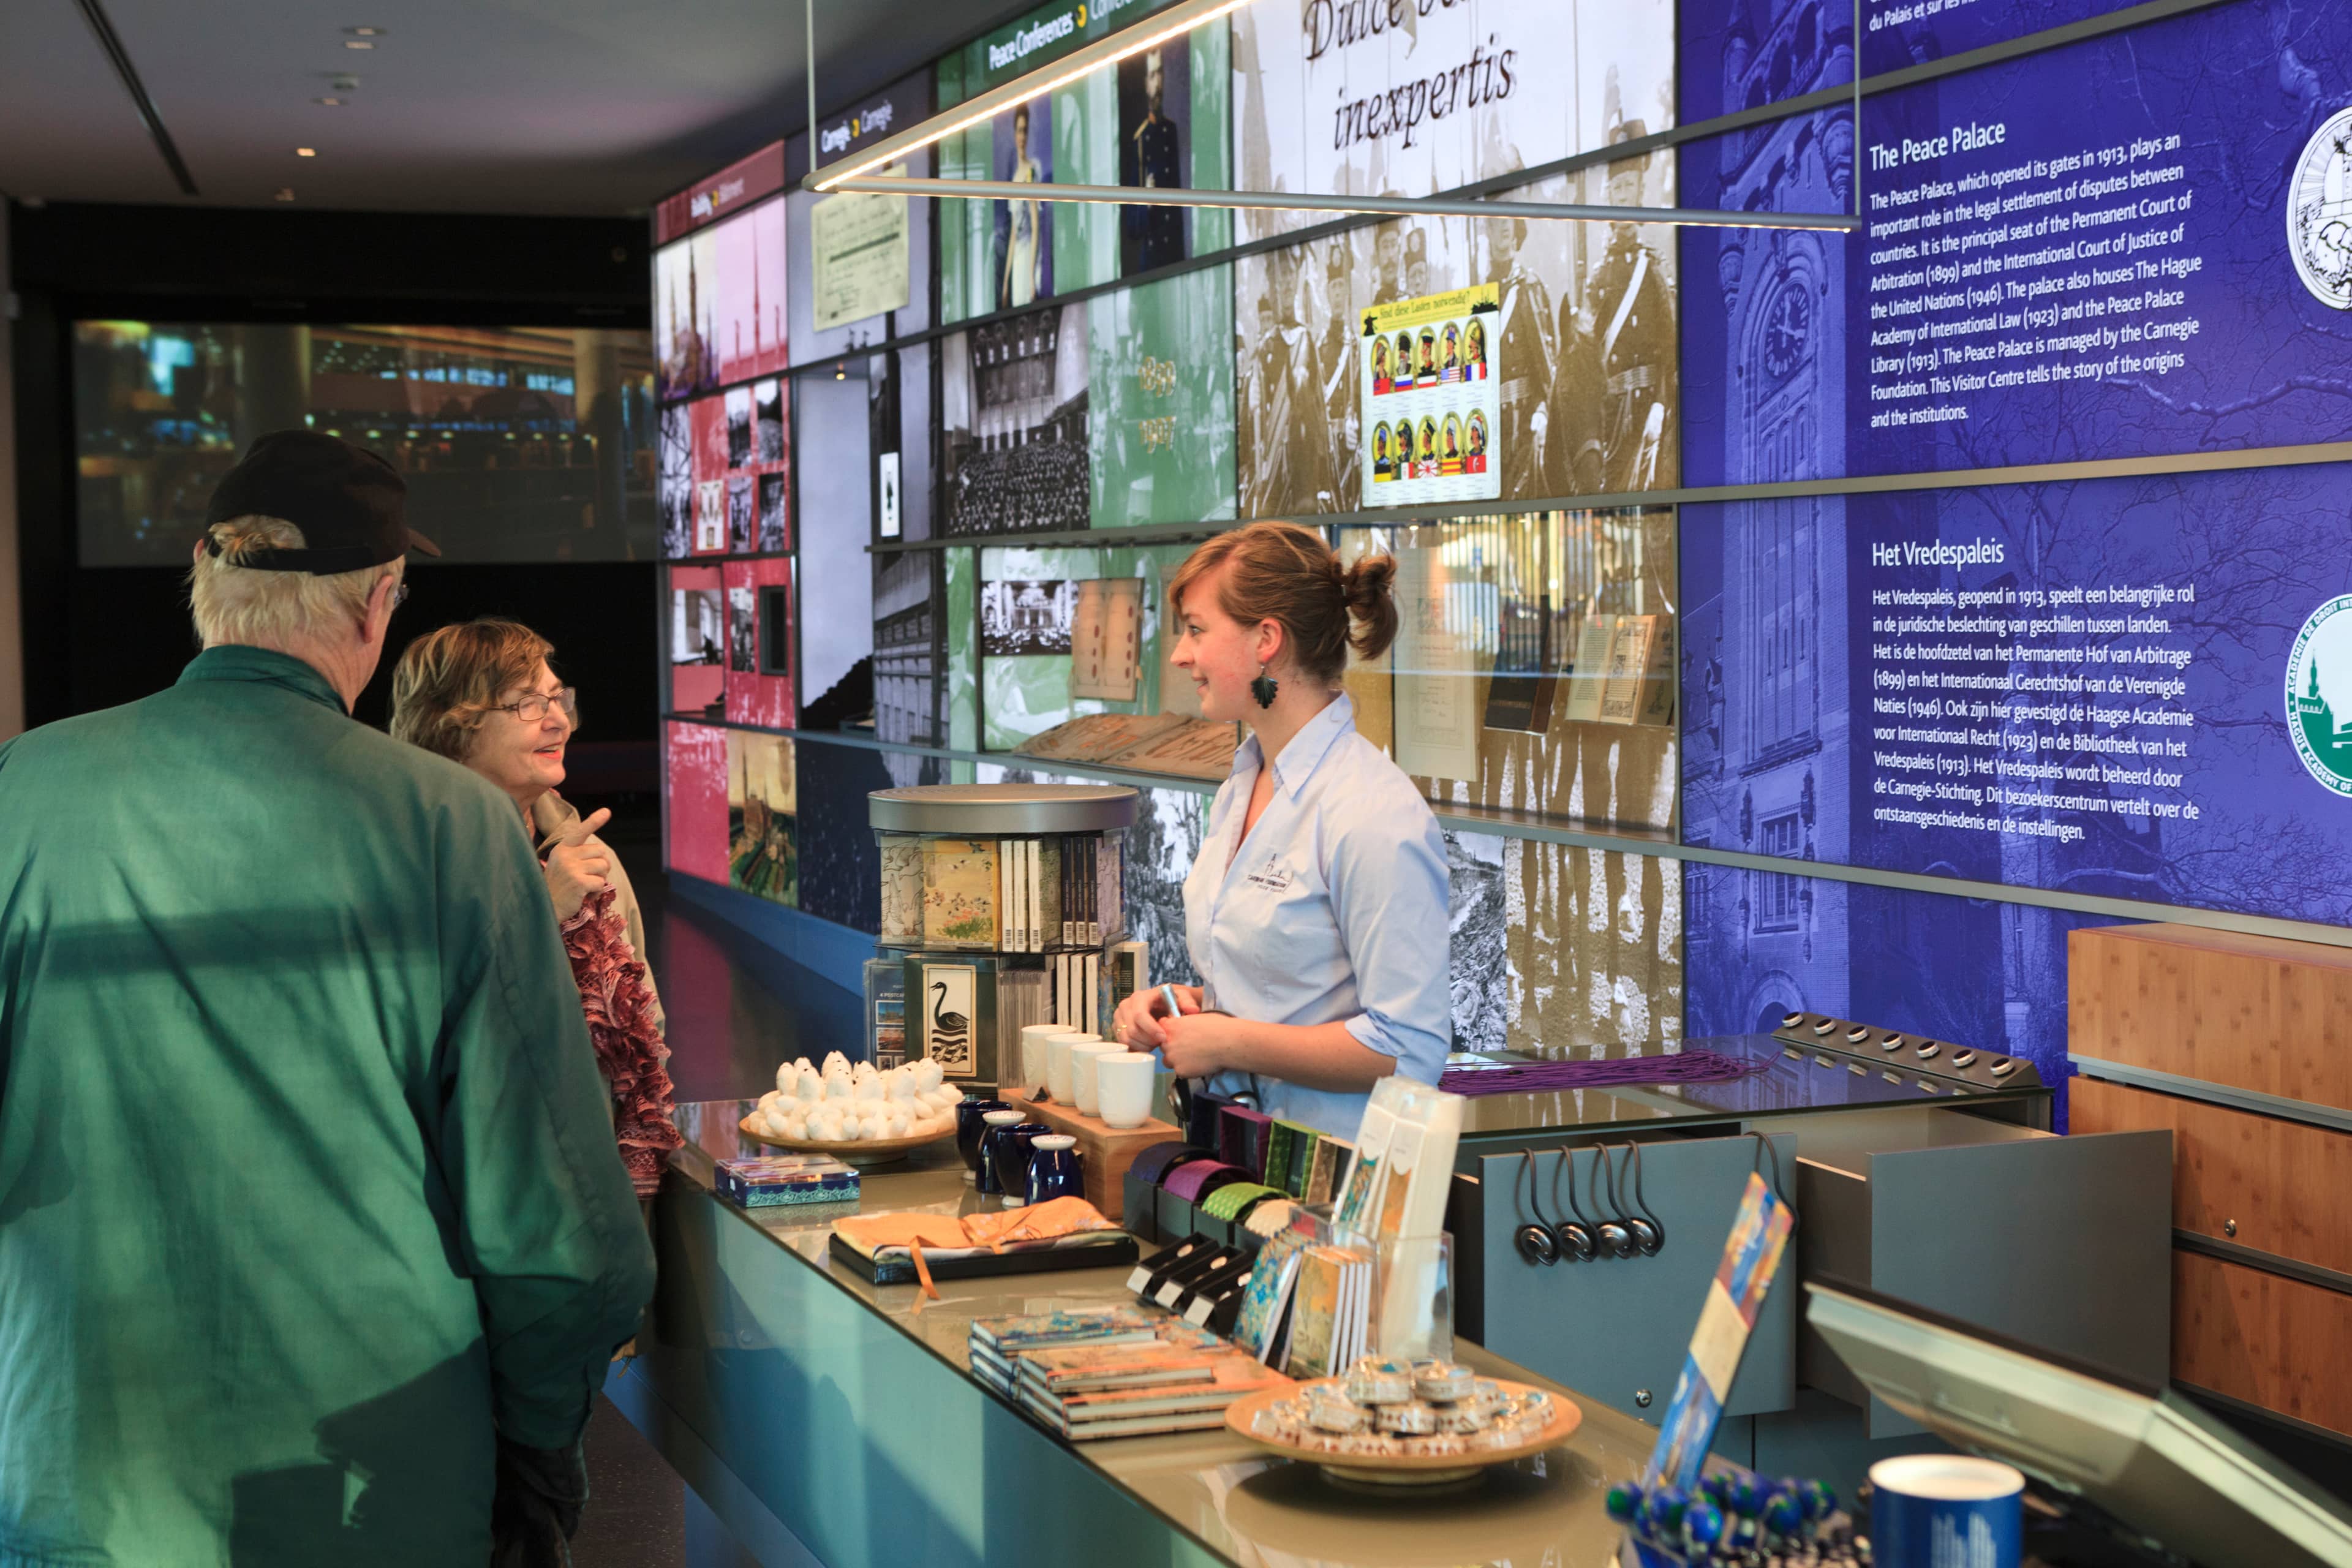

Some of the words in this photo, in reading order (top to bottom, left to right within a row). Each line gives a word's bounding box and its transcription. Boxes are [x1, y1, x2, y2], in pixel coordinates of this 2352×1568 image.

[989, 40, 1017, 71] Peace
[1016, 11, 1074, 58] Conferences
[1869, 13, 1882, 31] du
[1885, 5, 1912, 28] Palais
[1913, 2, 1925, 19] et
[1927, 0, 1943, 15] sur
[1335, 33, 1515, 151] inexpertis
[1869, 143, 1899, 171] The
[1902, 136, 1948, 164] Peace
[1952, 123, 2005, 153] Palace
[1870, 192, 1889, 210] The
[1890, 189, 1920, 206] Peace
[1921, 181, 1956, 200] Palace,
[1957, 170, 1989, 192] which
[1991, 160, 2032, 189] opened
[2034, 160, 2048, 177] its
[2049, 155, 2081, 179] gates
[2082, 149, 2095, 167] in
[2097, 146, 2128, 167] 1913,
[2130, 138, 2163, 163] plays
[2164, 134, 2180, 151] an
[1870, 215, 1920, 241] important
[1921, 209, 1942, 228] role
[1943, 208, 1953, 224] in
[1954, 204, 1973, 222] the
[1975, 197, 2000, 221] legal
[2002, 187, 2063, 213] settlement
[2064, 181, 2078, 201] of
[2079, 176, 2128, 200] disputes
[2130, 165, 2184, 189] between
[1870, 243, 1919, 265] countries.
[1921, 240, 1929, 256] It
[1931, 238, 1940, 254] is
[1942, 235, 1960, 252] the
[1961, 224, 2008, 254] principal
[2010, 222, 2034, 241] seat
[2035, 216, 2048, 236] of
[2049, 214, 2070, 233] the
[2072, 203, 2138, 229] Permanent
[2139, 195, 2176, 217] Court
[2177, 191, 2192, 211] of
[1870, 270, 1924, 292] Arbitration
[1926, 261, 1960, 287] (1899)
[1961, 258, 1982, 277] and
[1983, 256, 2002, 274] the
[2003, 241, 2075, 270] International
[2077, 238, 2111, 258] Court
[2112, 233, 2126, 253] of
[2127, 228, 2168, 255] Justice
[2170, 224, 2184, 243] of
[1871, 302, 1888, 320] the
[1888, 296, 1923, 317] United
[1924, 292, 1965, 311] Nations
[1967, 282, 2004, 309] (1946).
[2005, 281, 2027, 299] The
[2028, 276, 2065, 301] palace
[2067, 271, 2091, 290] also
[2092, 266, 2135, 286] houses
[2135, 260, 2158, 279] The
[2161, 256, 2203, 279] Hague
[1871, 327, 1917, 347] Academy
[1917, 322, 1929, 340] of
[1931, 312, 1997, 338] International
[1999, 312, 2021, 329] Law
[2023, 303, 2059, 330] (1923)
[2061, 300, 2083, 321] and
[2085, 298, 2105, 317] the
[2108, 296, 2143, 314] Peace
[2145, 289, 2185, 309] Palace
[1871, 356, 1905, 375] Library
[1907, 348, 1941, 373] (1913).
[1942, 347, 1962, 364] The
[1964, 345, 1996, 362] Peace
[1998, 339, 2034, 358] Palace
[2035, 336, 2045, 353] is
[2047, 328, 2101, 353] managed
[2103, 327, 2119, 350] by
[2120, 325, 2142, 343] the
[2143, 317, 2199, 341] Carnegie
[1139, 356, 1177, 398] 1899
[1871, 380, 1928, 401] Foundation.
[1929, 377, 1951, 394] This
[1951, 374, 1987, 391] Visitor
[1988, 371, 2025, 388] Centre
[2026, 364, 2051, 384] tells
[2051, 363, 2071, 381] the
[2073, 362, 2104, 382] story
[2105, 356, 2119, 375] of
[2120, 355, 2141, 374] the
[2143, 350, 2185, 375] origins
[1139, 416, 1177, 454] 1907
[1871, 410, 1890, 428] and
[1891, 409, 1908, 426] the
[1909, 404, 1969, 424] institutions.
[1872, 542, 1901, 567] Het
[1903, 537, 2005, 572] Vredespaleis
[1872, 590, 1891, 605] Het
[1891, 587, 1956, 609] Vredespaleis,
[1958, 586, 2003, 609] geopend
[2005, 587, 2016, 604] in
[2018, 590, 2047, 608] 1913,
[2049, 586, 2084, 608] speelt
[2085, 590, 2107, 603] een
[2109, 584, 2175, 608] belangrijke
[2177, 584, 2195, 603] rol
[1873, 616, 1883, 632] in
[1883, 616, 1897, 632] de
[1898, 616, 1945, 637] juridische
[1947, 616, 2007, 638] beslechting
[2007, 620, 2028, 633] van
[2029, 615, 2085, 638] geschillen
[2087, 617, 2125, 633] tussen
[2127, 615, 2172, 633] landen.
[2288, 637, 2307, 694] ACADEMIE
[2304, 622, 2315, 638] DE
[2313, 601, 2339, 624] DROIT
[1874, 669, 1905, 691] (1899)
[1907, 674, 1920, 687] en
[1921, 671, 1939, 688] het
[1941, 672, 2013, 690] Internationaal
[2015, 673, 2084, 692] Gerechtshof
[2085, 679, 2106, 693] van
[2108, 675, 2124, 693] de
[2124, 676, 2186, 700] Verenigde
[2290, 711, 2306, 750] HAGUE
[2303, 752, 2339, 788] ACADEMY
[2340, 782, 2351, 792] OF
[1874, 777, 1887, 794] de
[1888, 778, 1984, 807] Carnegie-Stichting.
[1986, 786, 2003, 804] Dit
[2005, 786, 2108, 812] bezoekerscentrum
[2110, 797, 2150, 816] vertelt
[2153, 803, 2181, 818] over
[2182, 801, 2199, 820] de
[1874, 807, 1985, 831] ontstaansgeschiedenis
[1986, 818, 2000, 831] en
[2002, 815, 2016, 833] de
[2018, 817, 2085, 843] instellingen.
